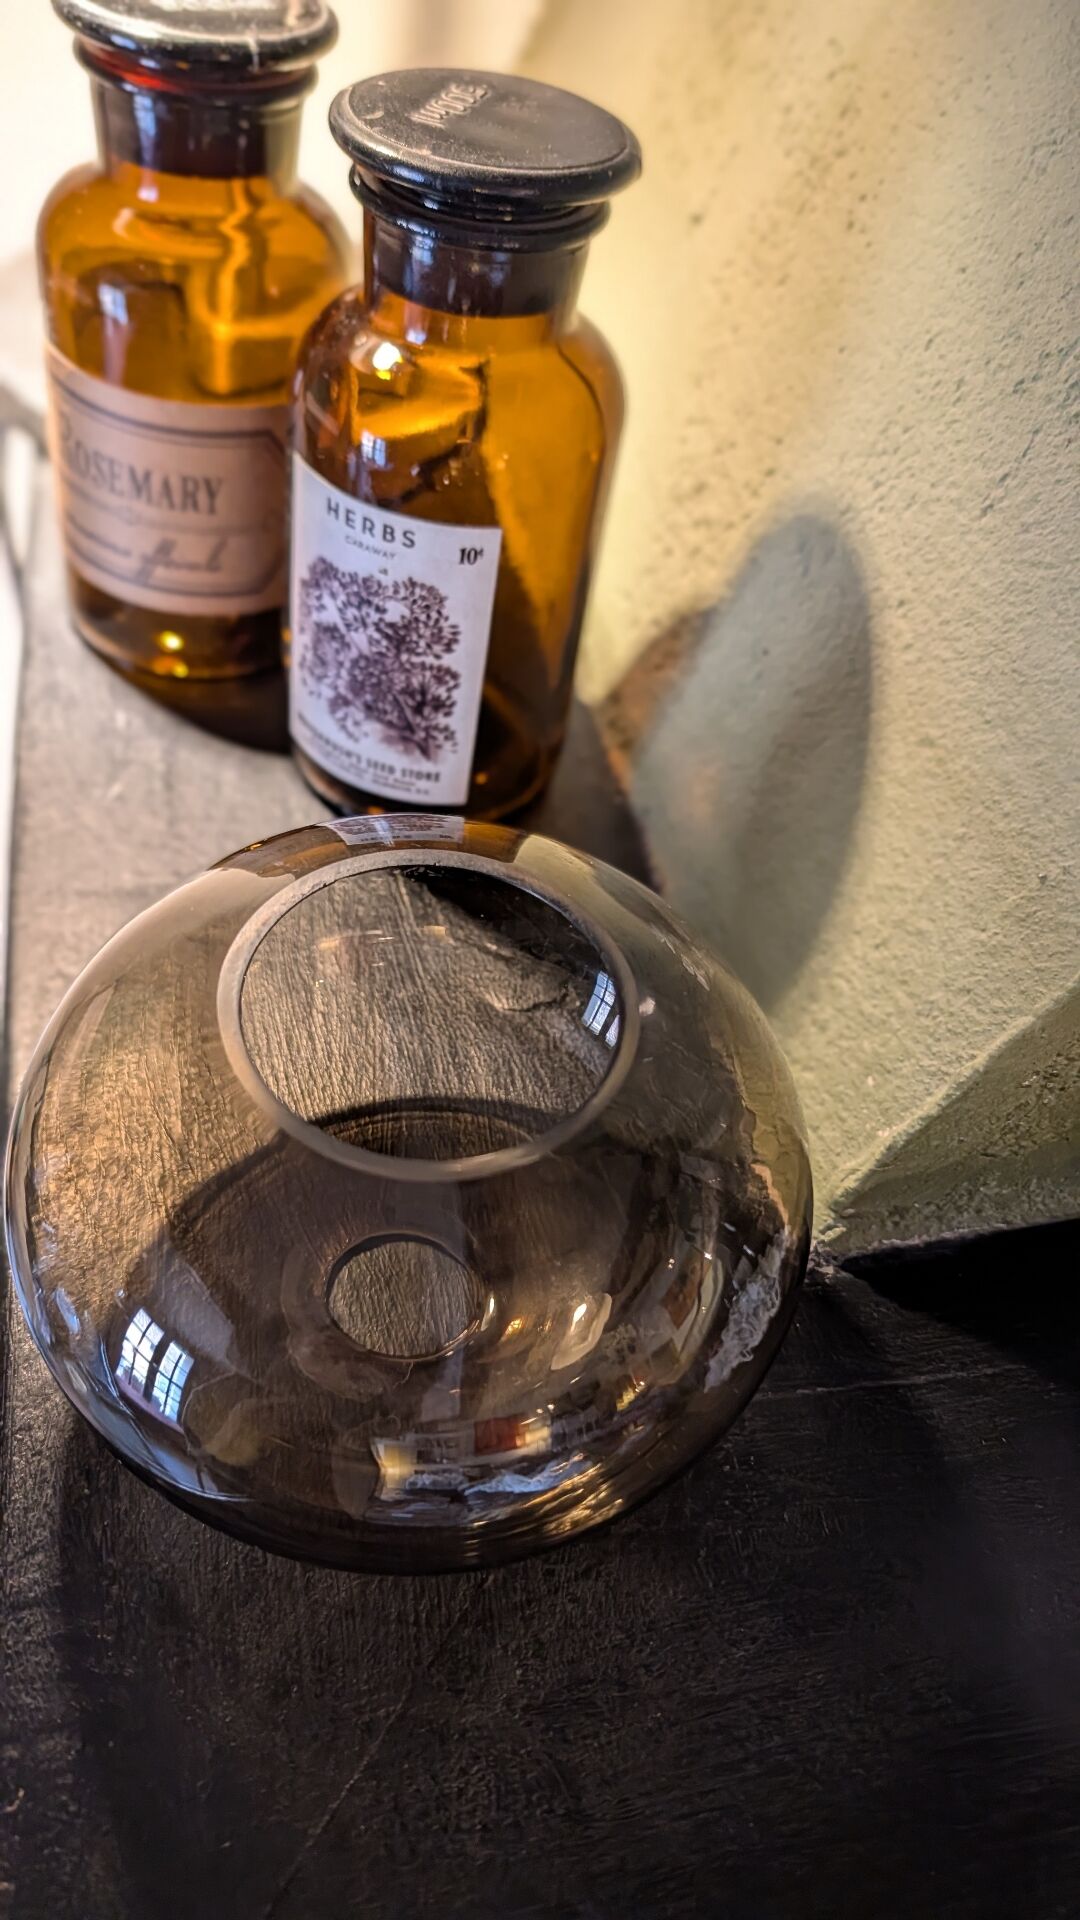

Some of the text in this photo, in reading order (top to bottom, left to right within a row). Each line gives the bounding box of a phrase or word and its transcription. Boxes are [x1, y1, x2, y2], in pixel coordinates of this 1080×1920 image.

[326, 497, 416, 549] HERBS
[344, 534, 398, 561] CARAWAY
[366, 757, 395, 775] SEED
[401, 769, 442, 784] STORE
